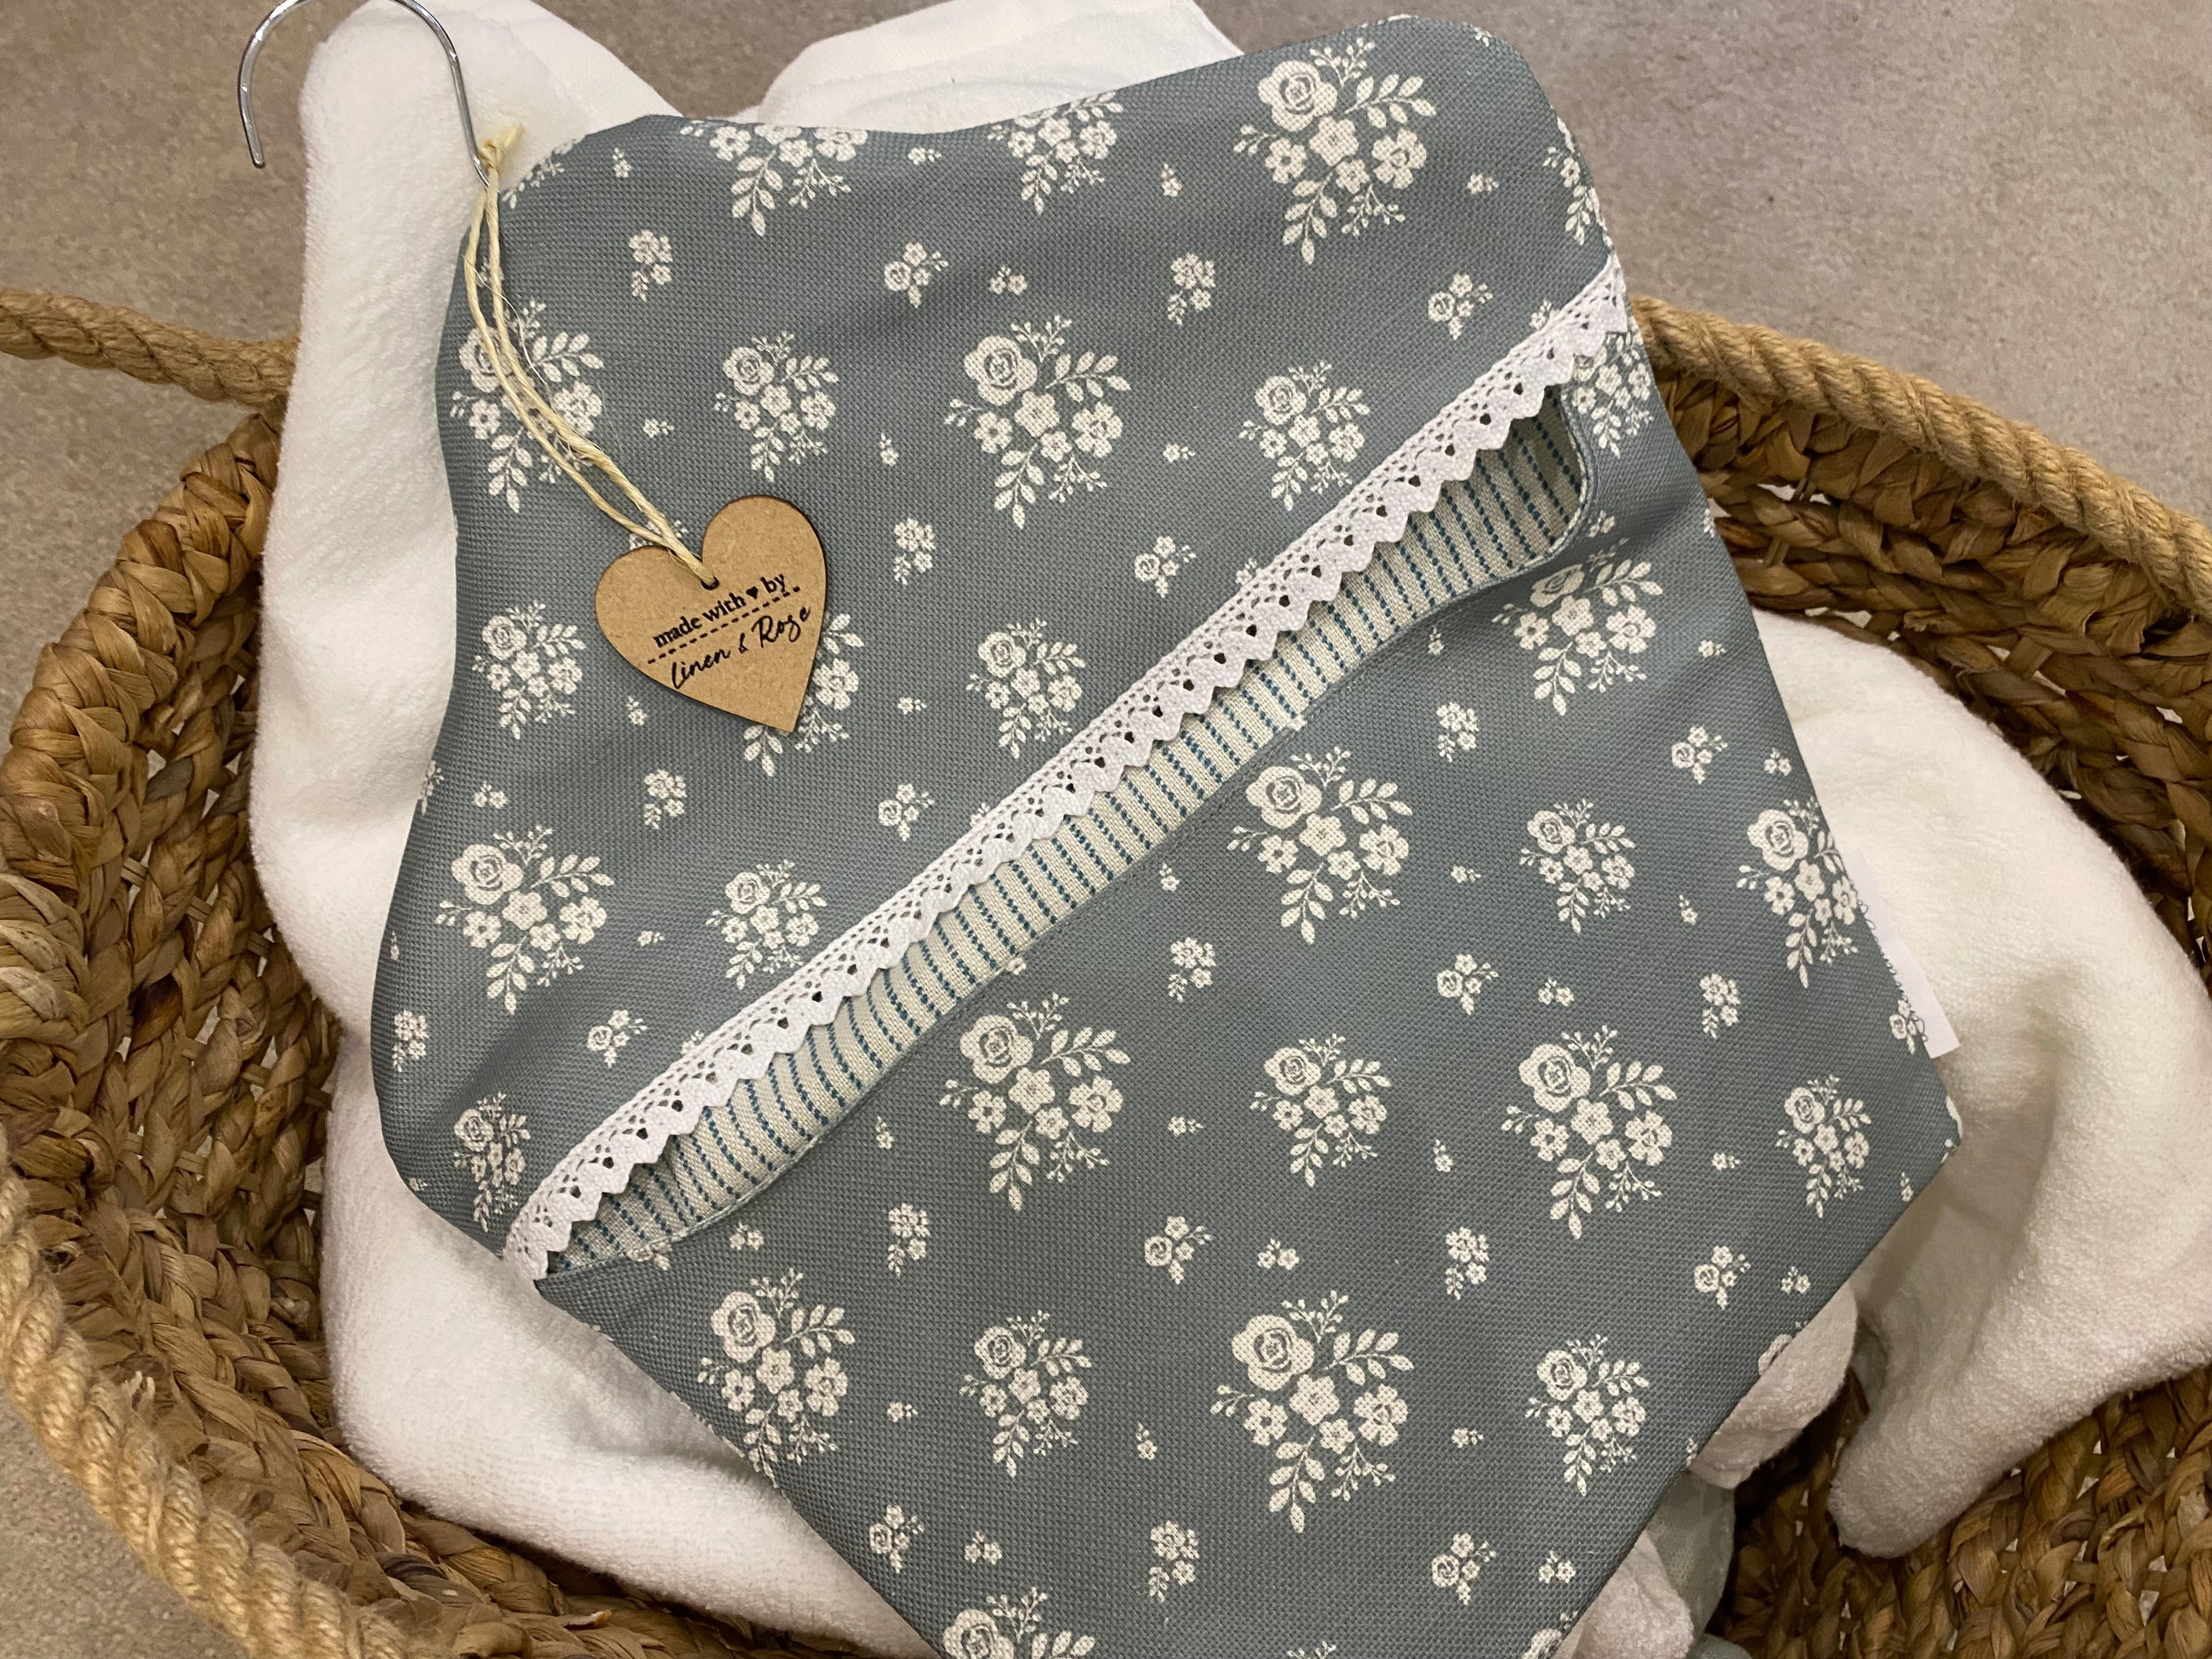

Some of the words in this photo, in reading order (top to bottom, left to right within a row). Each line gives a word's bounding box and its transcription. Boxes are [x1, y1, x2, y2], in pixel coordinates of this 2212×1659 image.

[653, 616, 703, 648] made
[703, 592, 747, 622] with
[760, 573, 787, 594] by
[671, 647, 731, 690] Linen
[738, 633, 749, 654] &
[752, 607, 810, 649] Rose
